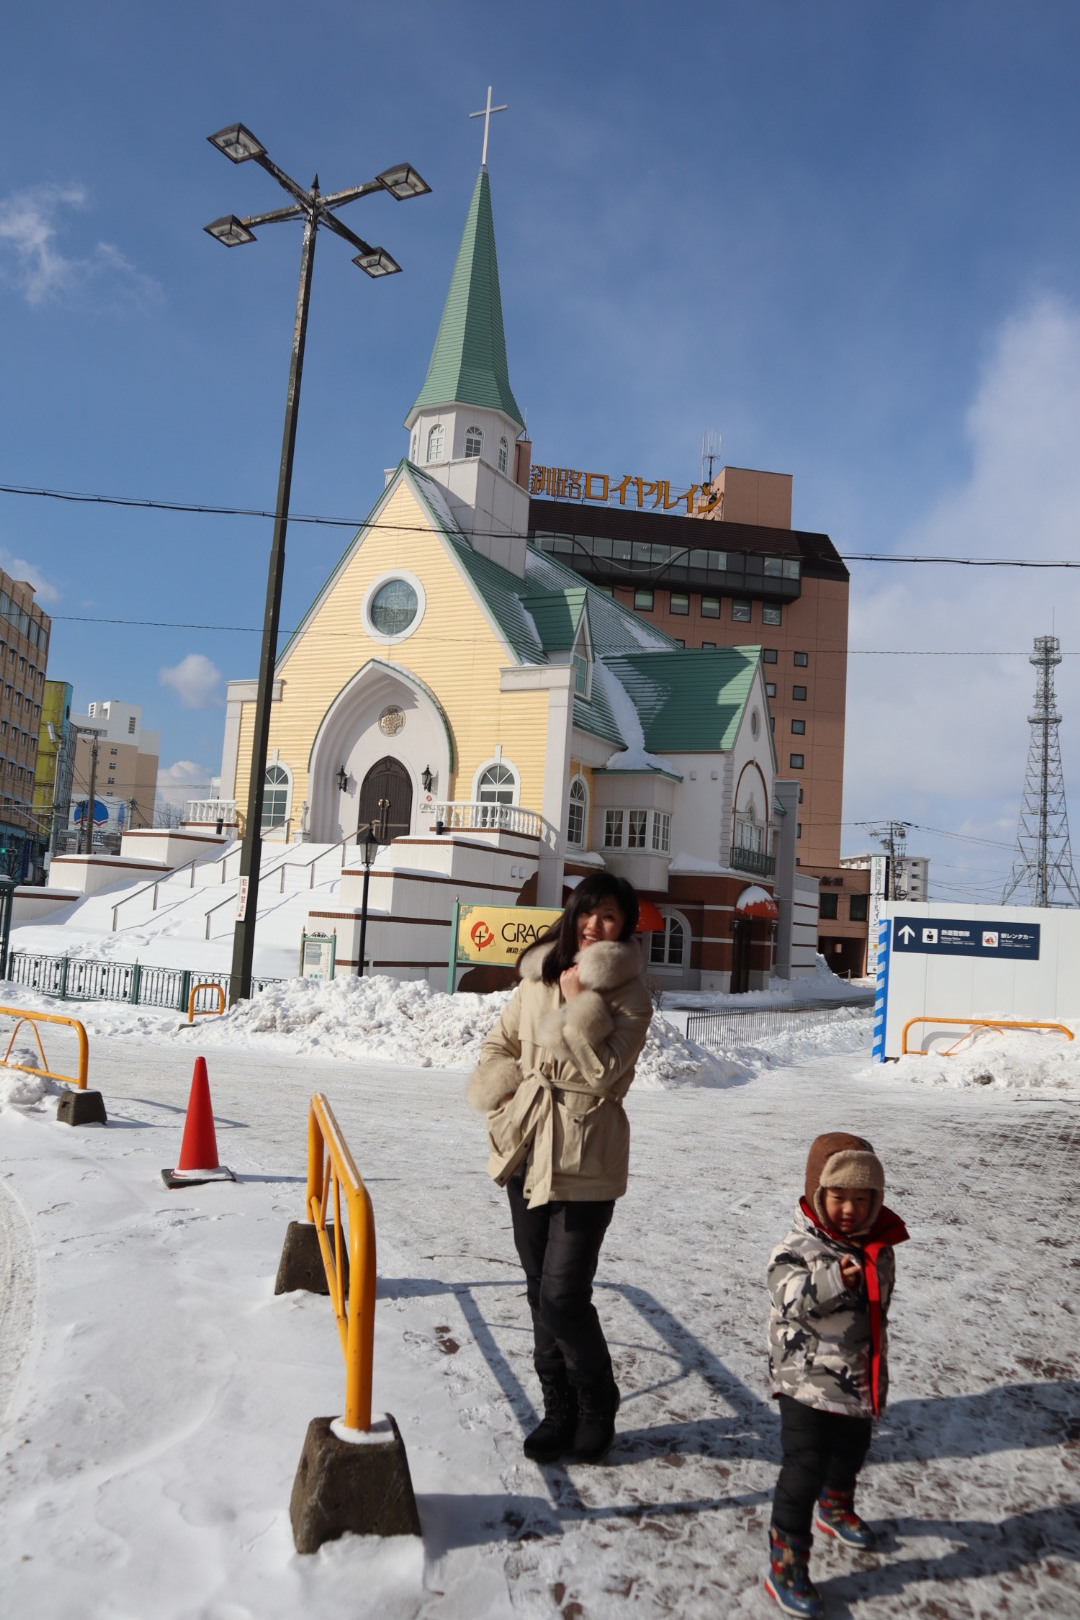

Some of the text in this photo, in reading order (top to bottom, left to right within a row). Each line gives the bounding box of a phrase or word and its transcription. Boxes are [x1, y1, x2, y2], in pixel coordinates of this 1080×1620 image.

[530, 464, 725, 514] 釧路ロイヤルイン
